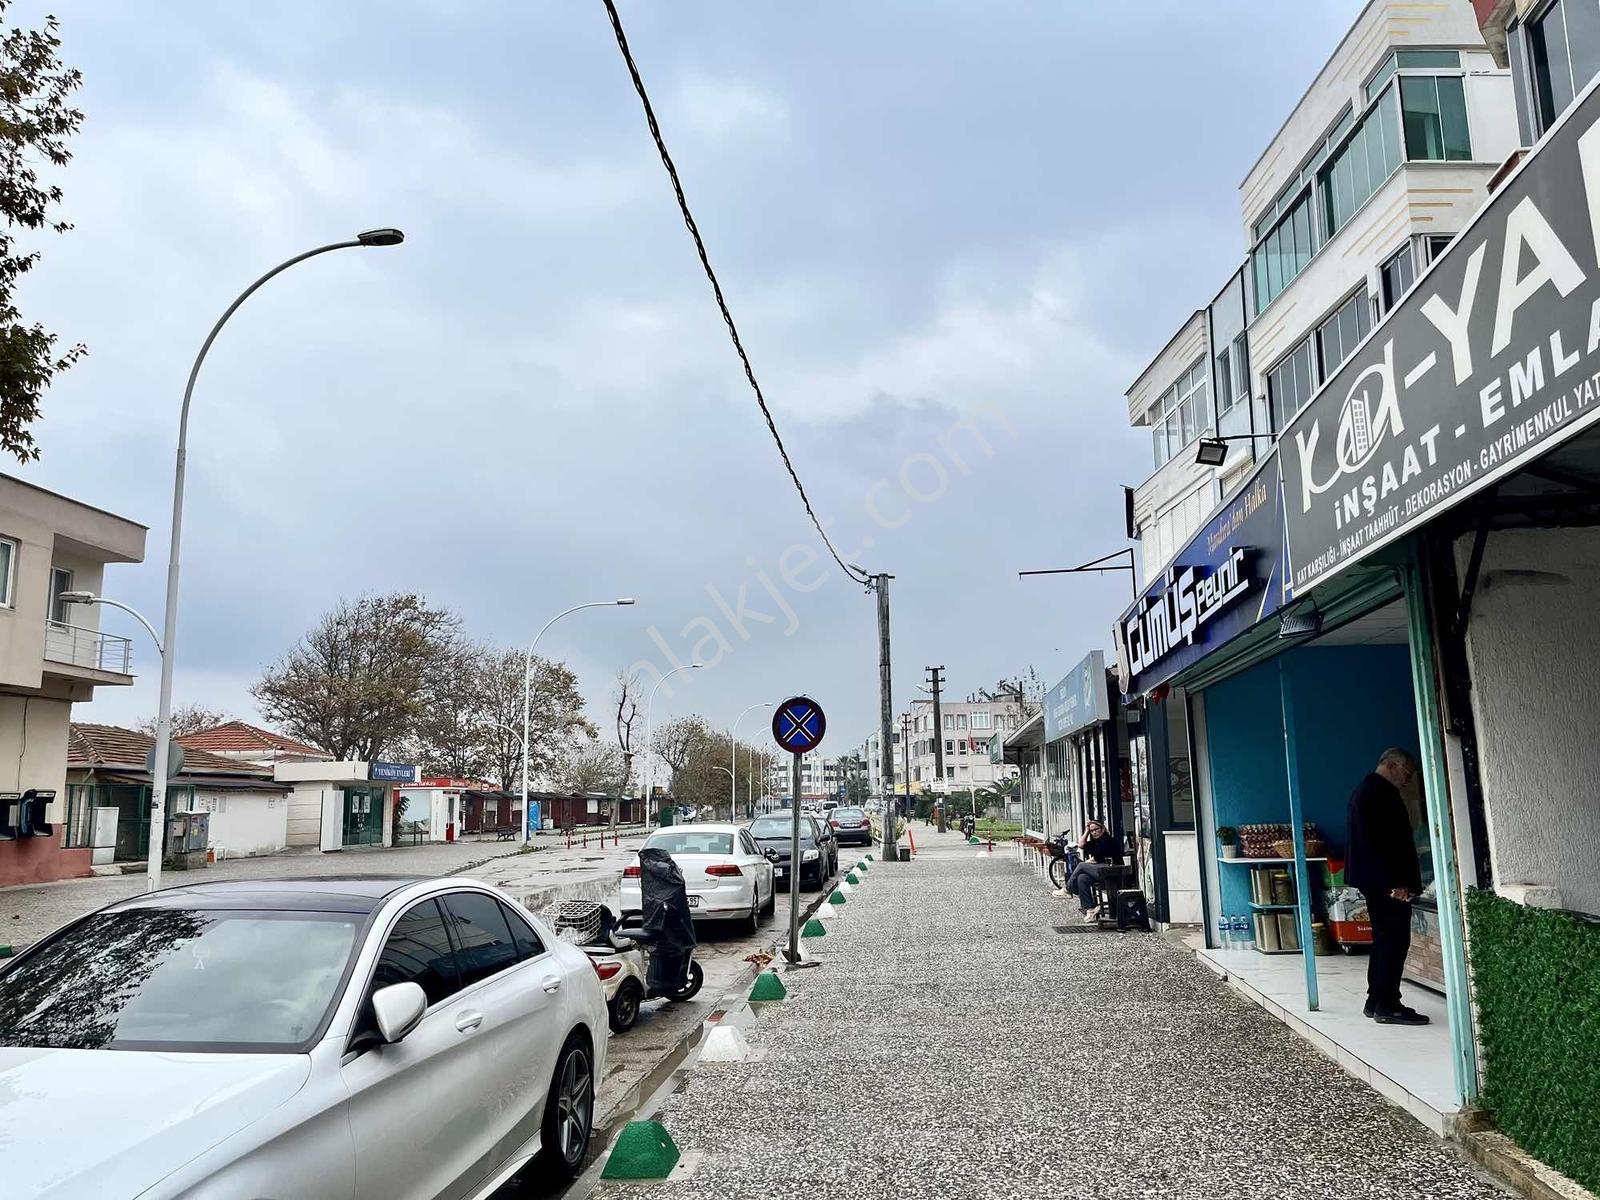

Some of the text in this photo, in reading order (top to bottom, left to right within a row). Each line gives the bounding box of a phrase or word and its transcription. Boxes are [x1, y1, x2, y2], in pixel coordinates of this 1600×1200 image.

[1334, 424, 1440, 530] İNŞAAT
[1405, 459, 1471, 516] DEKORASYON
[1480, 395, 1572, 470] GAYRİMENKUL
